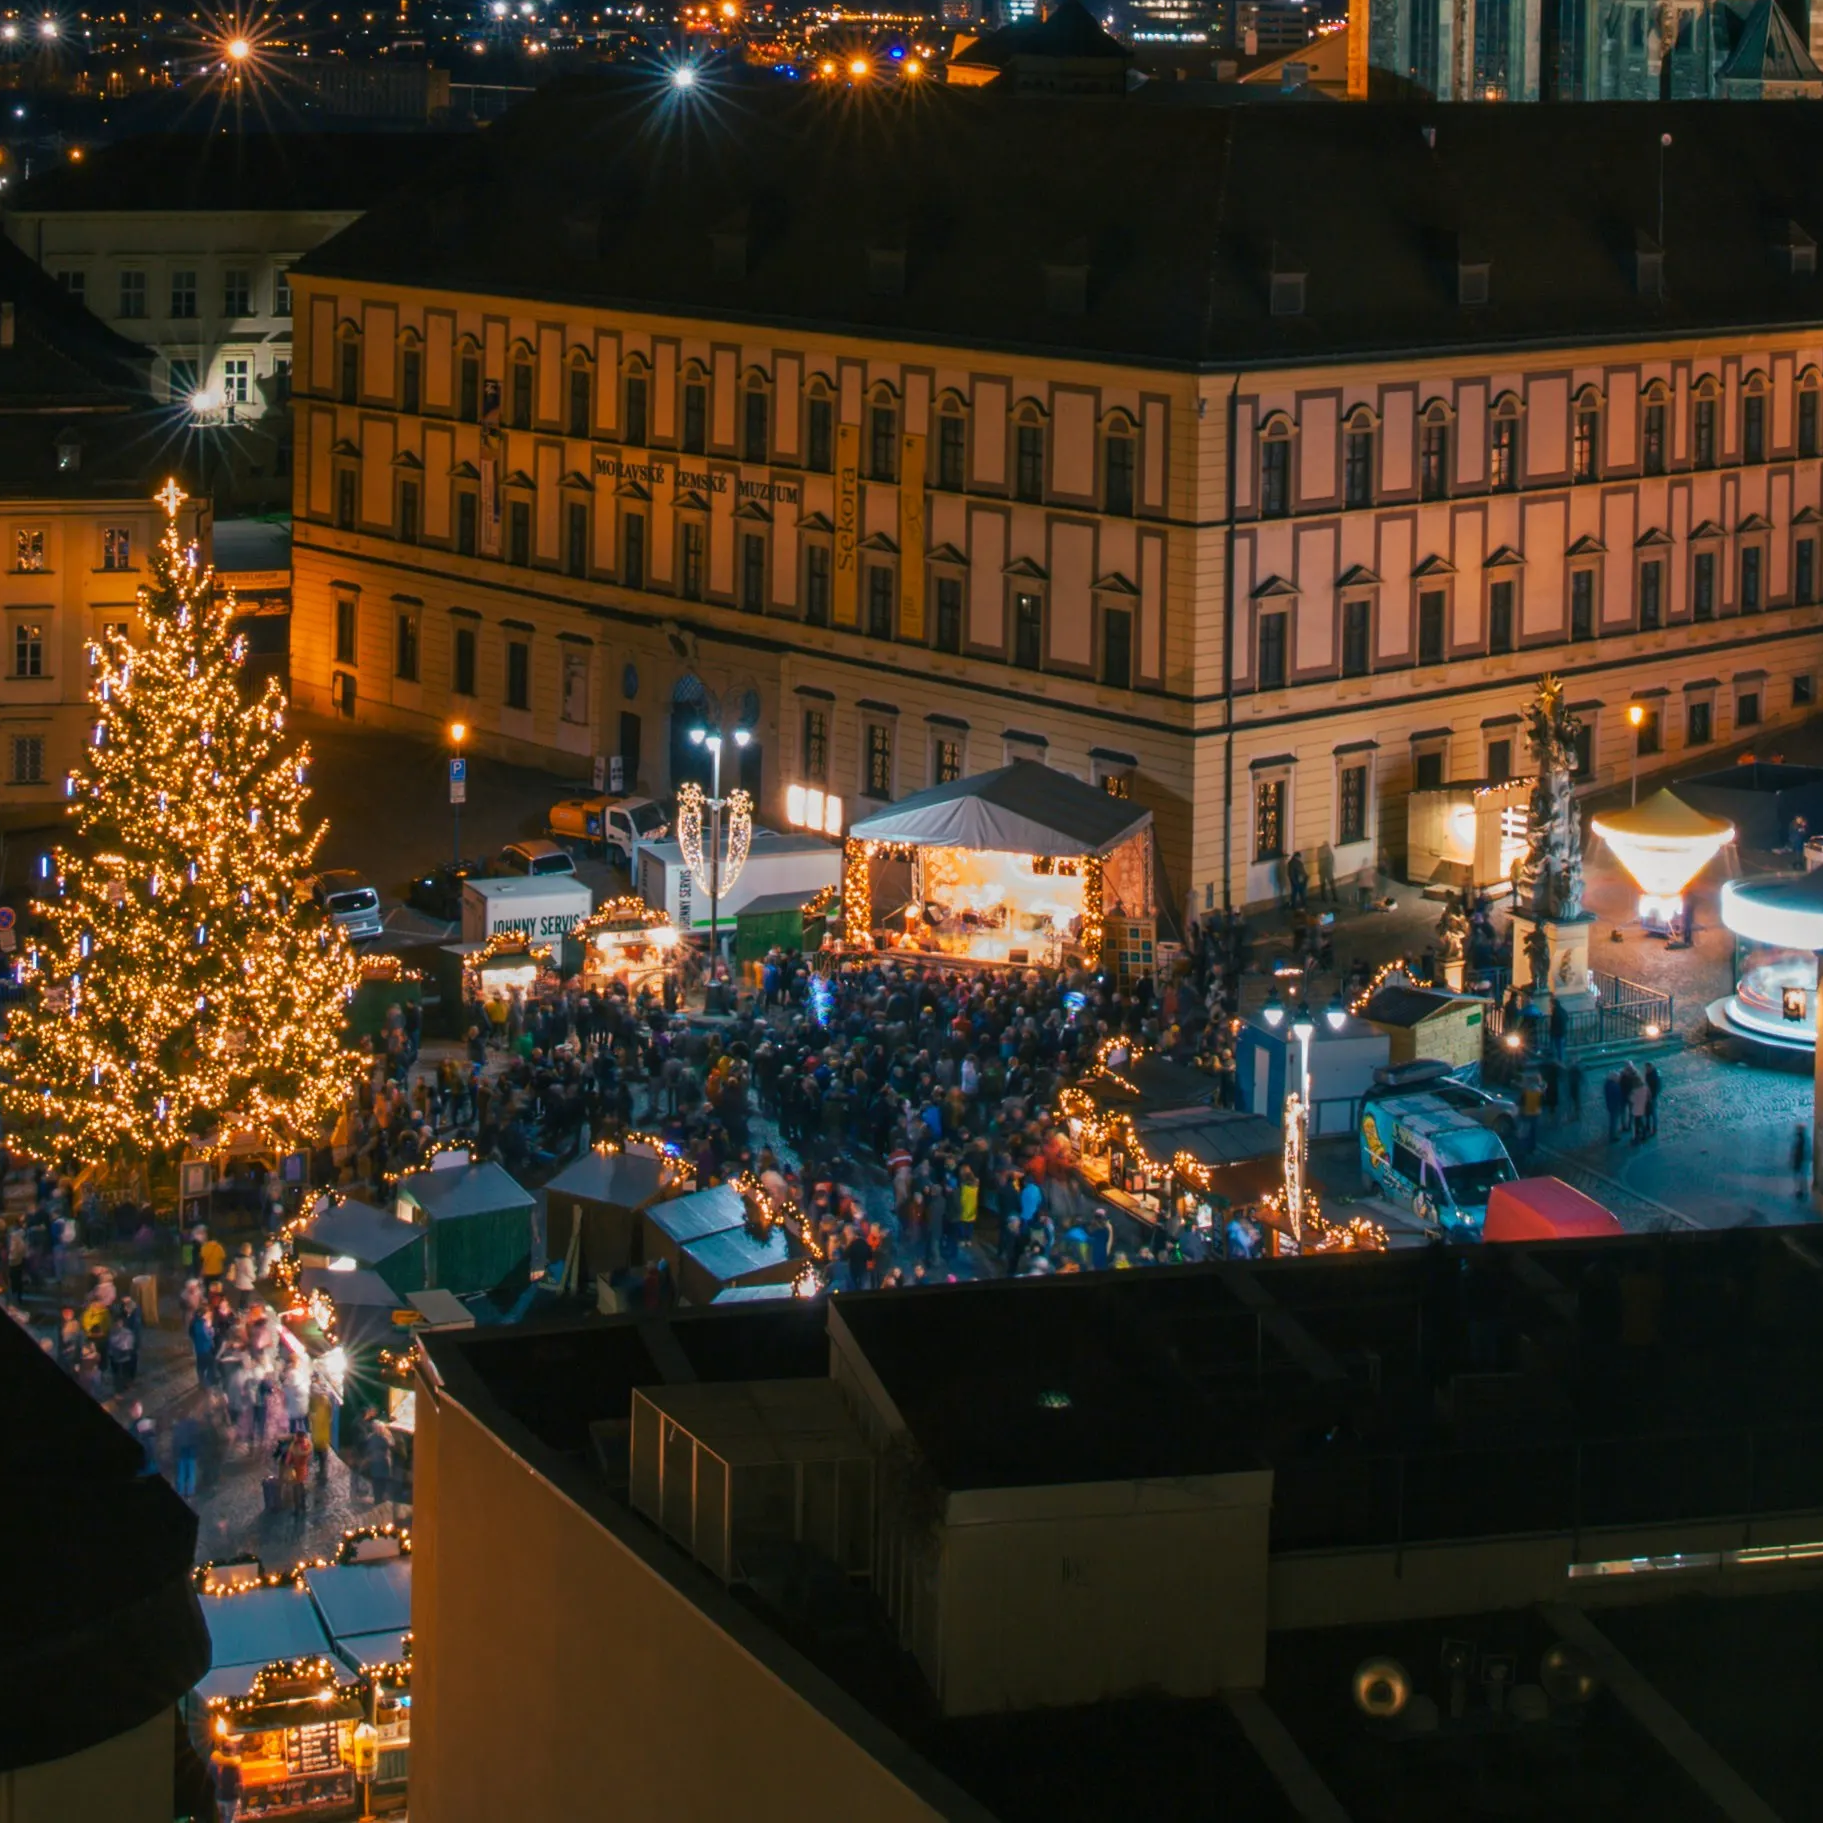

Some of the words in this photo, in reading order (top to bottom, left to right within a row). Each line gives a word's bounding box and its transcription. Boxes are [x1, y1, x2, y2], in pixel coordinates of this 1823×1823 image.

[596, 459, 665, 484] MORAVSKÉ
[674, 471, 727, 493] ZEMSKÉ
[738, 480, 798, 504] MUZEUM
[836, 467, 855, 571] Sekora
[453, 761, 462, 775] P
